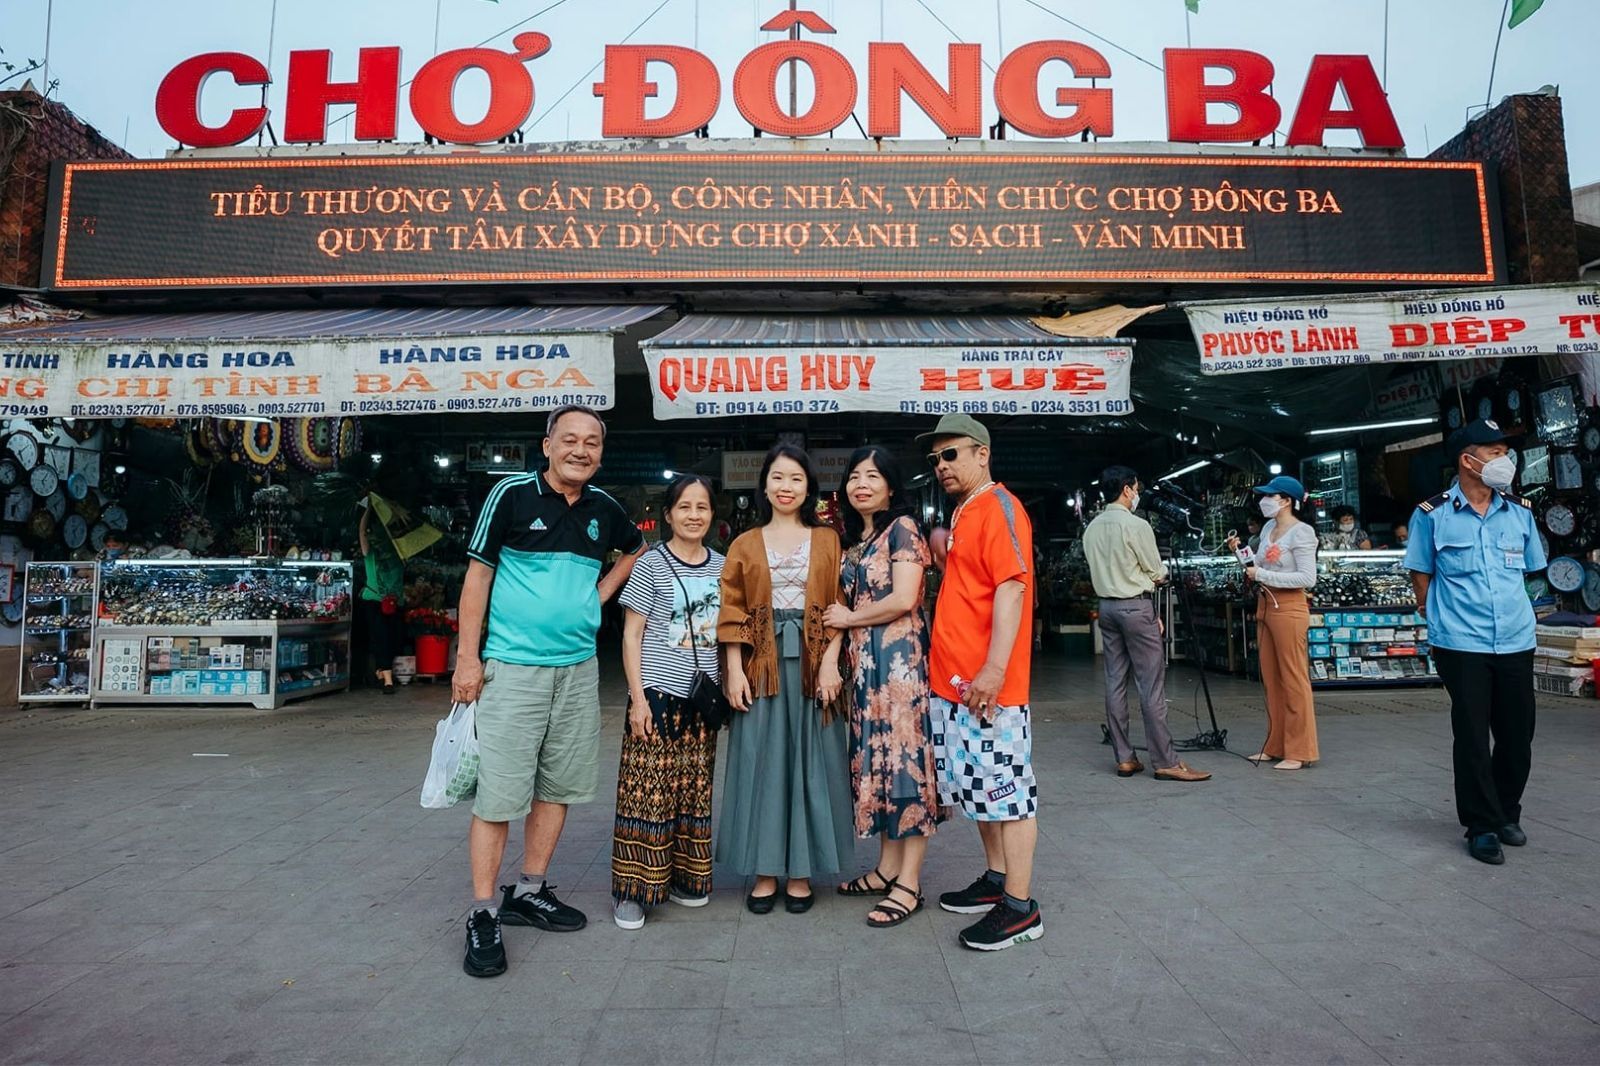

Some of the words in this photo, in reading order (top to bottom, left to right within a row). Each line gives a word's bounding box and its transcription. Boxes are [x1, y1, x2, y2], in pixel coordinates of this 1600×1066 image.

[593, 9, 1113, 139] ĐÔNG
[1163, 48, 1406, 148] BA
[301, 186, 451, 215] THƯƠNG
[461, 181, 507, 212] VÀ
[518, 180, 593, 211] CÁN
[603, 183, 660, 217] BỘ,
[671, 177, 774, 209] CÔNG
[783, 178, 894, 214] NHÂN,
[904, 178, 988, 210] VIÊN
[997, 180, 1098, 211] CHỨC
[1107, 186, 1182, 218] CHỢ
[1190, 180, 1288, 213] ĐÔNG
[1296, 189, 1342, 213] BA
[317, 219, 437, 257] QUYẾT
[446, 217, 526, 250] TÂM
[533, 216, 607, 249] XÂY
[617, 219, 722, 256] DỰNG
[731, 222, 811, 254] CHỢ
[818, 223, 919, 247] XANH
[950, 223, 1043, 255] SẠCH
[1072, 218, 1142, 249] VĂN
[1150, 225, 1246, 249] MINH
[1202, 326, 1285, 357] PHƯỚC
[1290, 324, 1359, 353] LÀNH
[1389, 316, 1526, 348] DIỆP
[107, 350, 208, 369] HÀNG
[222, 351, 295, 368] HOA
[380, 345, 482, 364] HÀNG
[496, 343, 570, 361] HOA
[1246, 360, 1263, 369] 522
[77, 377, 173, 402] CHỊ
[193, 371, 321, 397] TÌNH
[353, 366, 438, 394] BÀ
[460, 366, 594, 391] NGA
[660, 355, 788, 402] QUANG
[801, 354, 876, 391] HUY
[89, 403, 165, 416] 02343.527701
[178, 403, 246, 415] 076.8595964
[258, 402, 325, 415] 0903.527701
[360, 400, 436, 411] 02343.527476
[447, 397, 521, 410] 0903.527.476
[726, 401, 767, 414] 0914
[773, 400, 803, 412] 050
[809, 399, 839, 412] 374
[925, 400, 958, 413] 0935
[963, 400, 988, 413] 668
[992, 400, 1017, 413] 646
[1032, 400, 1064, 413] 0234
[1069, 400, 1100, 412] 3531
[1106, 400, 1129, 412] 601
[992, 785, 1015, 799] ITALIA
